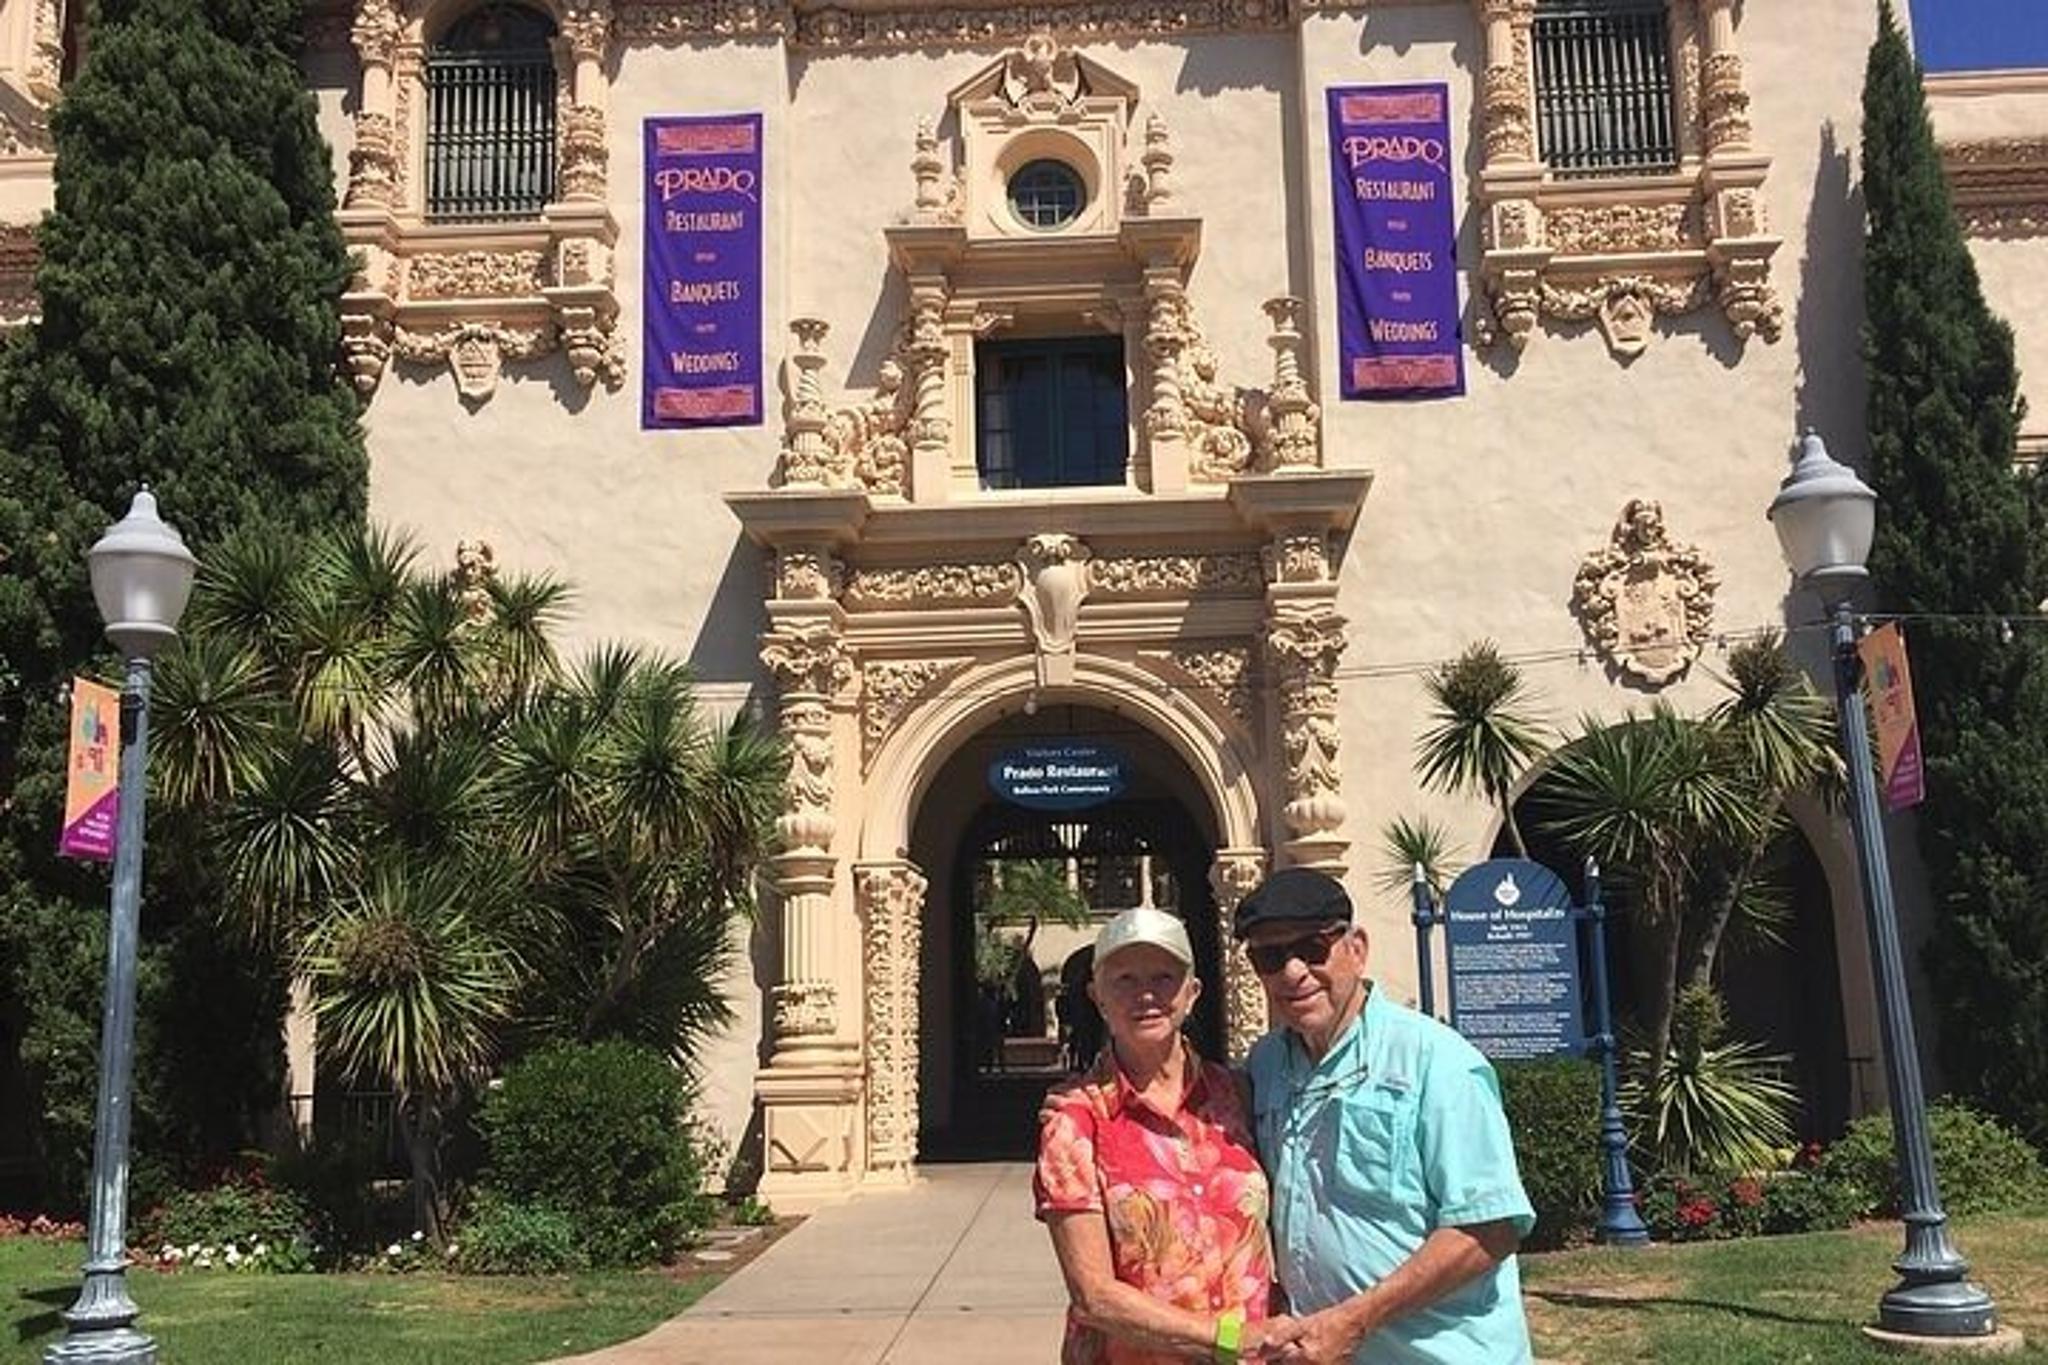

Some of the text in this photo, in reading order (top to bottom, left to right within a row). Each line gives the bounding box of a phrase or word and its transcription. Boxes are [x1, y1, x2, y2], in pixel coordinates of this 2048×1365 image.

[1342, 136, 1446, 172] PRADO
[654, 166, 758, 202] PRADO
[1355, 178, 1436, 200] RESTAURANT
[665, 210, 744, 232] RESTAURANT
[1364, 249, 1433, 273] BANQUETS
[670, 280, 740, 307] BANQUETS
[1370, 319, 1438, 341] WEDDINGS
[671, 351, 740, 374] WEDDINGS
[1003, 765, 1044, 780] Prado
[1450, 907, 1565, 922] House of Hospitality
